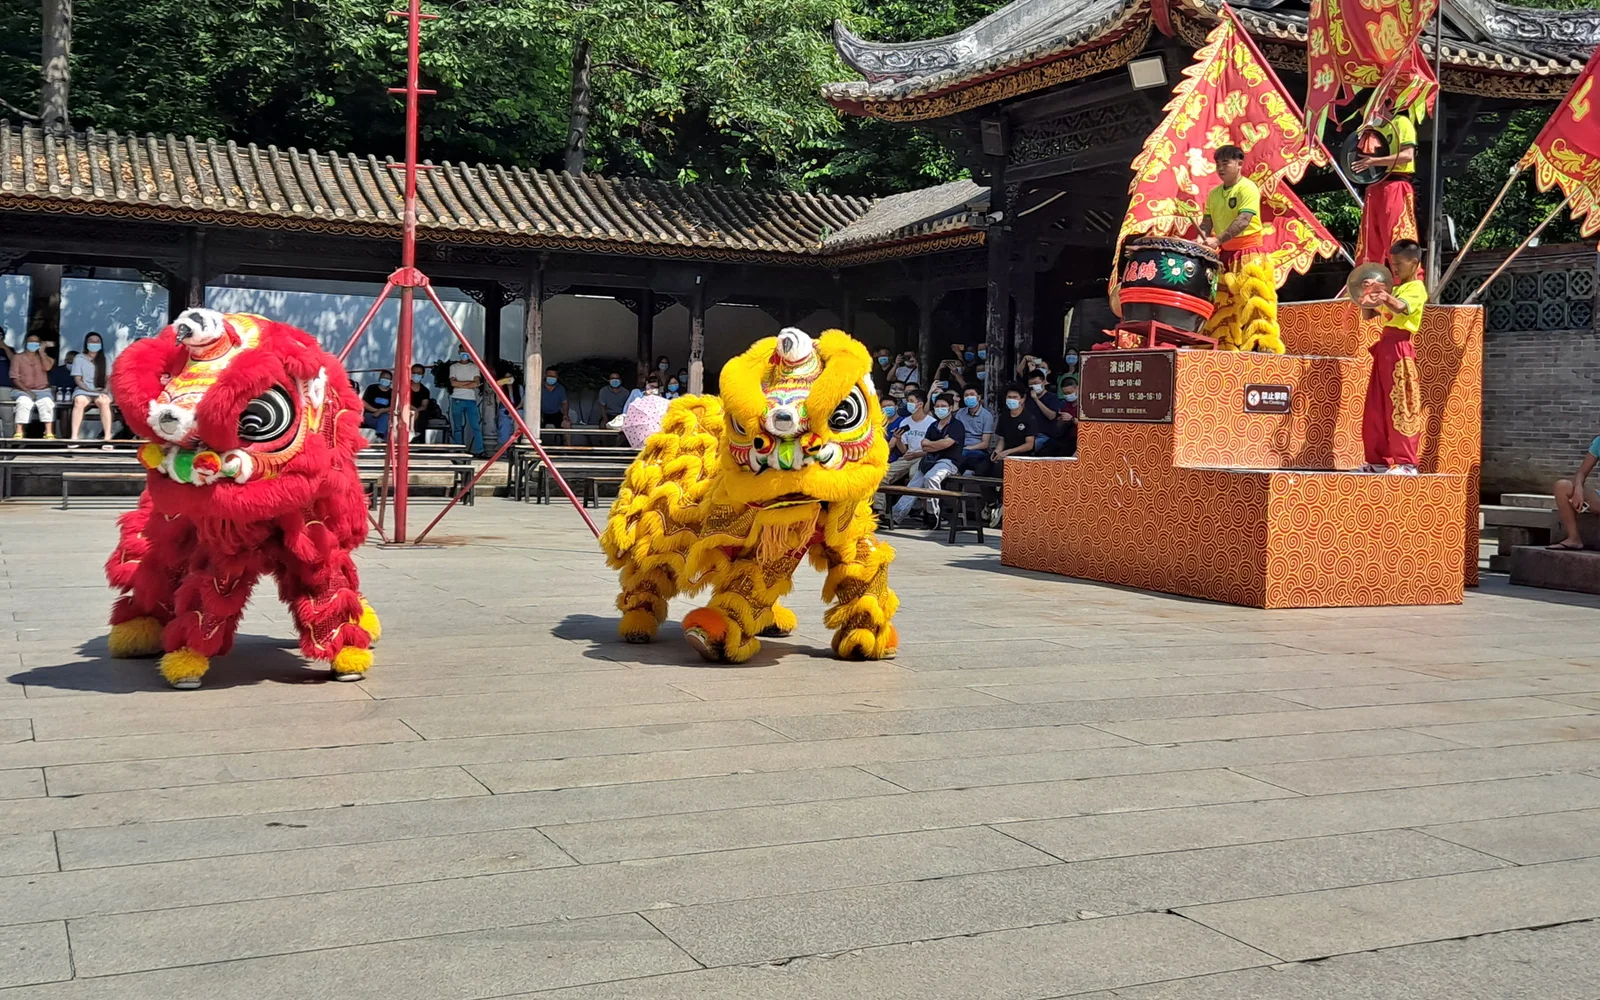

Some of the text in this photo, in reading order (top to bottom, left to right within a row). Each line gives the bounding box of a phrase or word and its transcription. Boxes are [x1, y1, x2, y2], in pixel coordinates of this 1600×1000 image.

[1109, 360, 1142, 373] 演出时间
[1109, 379, 1142, 387] 10:00-10:40
